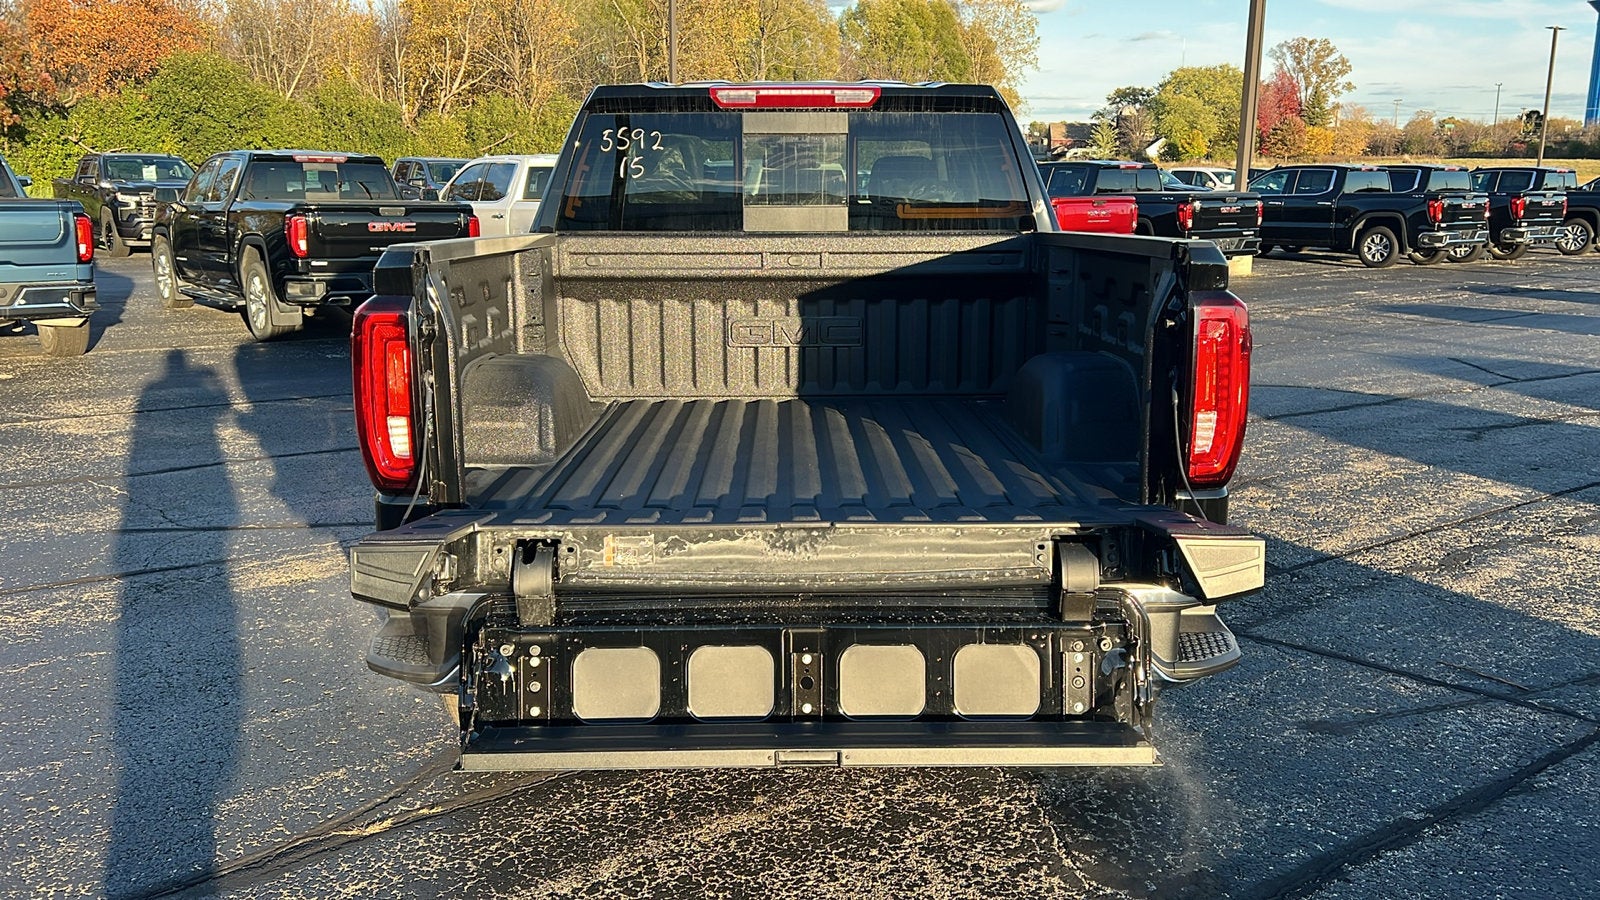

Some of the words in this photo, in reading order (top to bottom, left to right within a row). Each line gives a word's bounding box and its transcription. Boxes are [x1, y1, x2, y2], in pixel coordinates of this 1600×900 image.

[600, 126, 664, 152] 5592
[620, 156, 645, 179] 15
[367, 222, 417, 232] GMC
[730, 319, 861, 345] GMC
